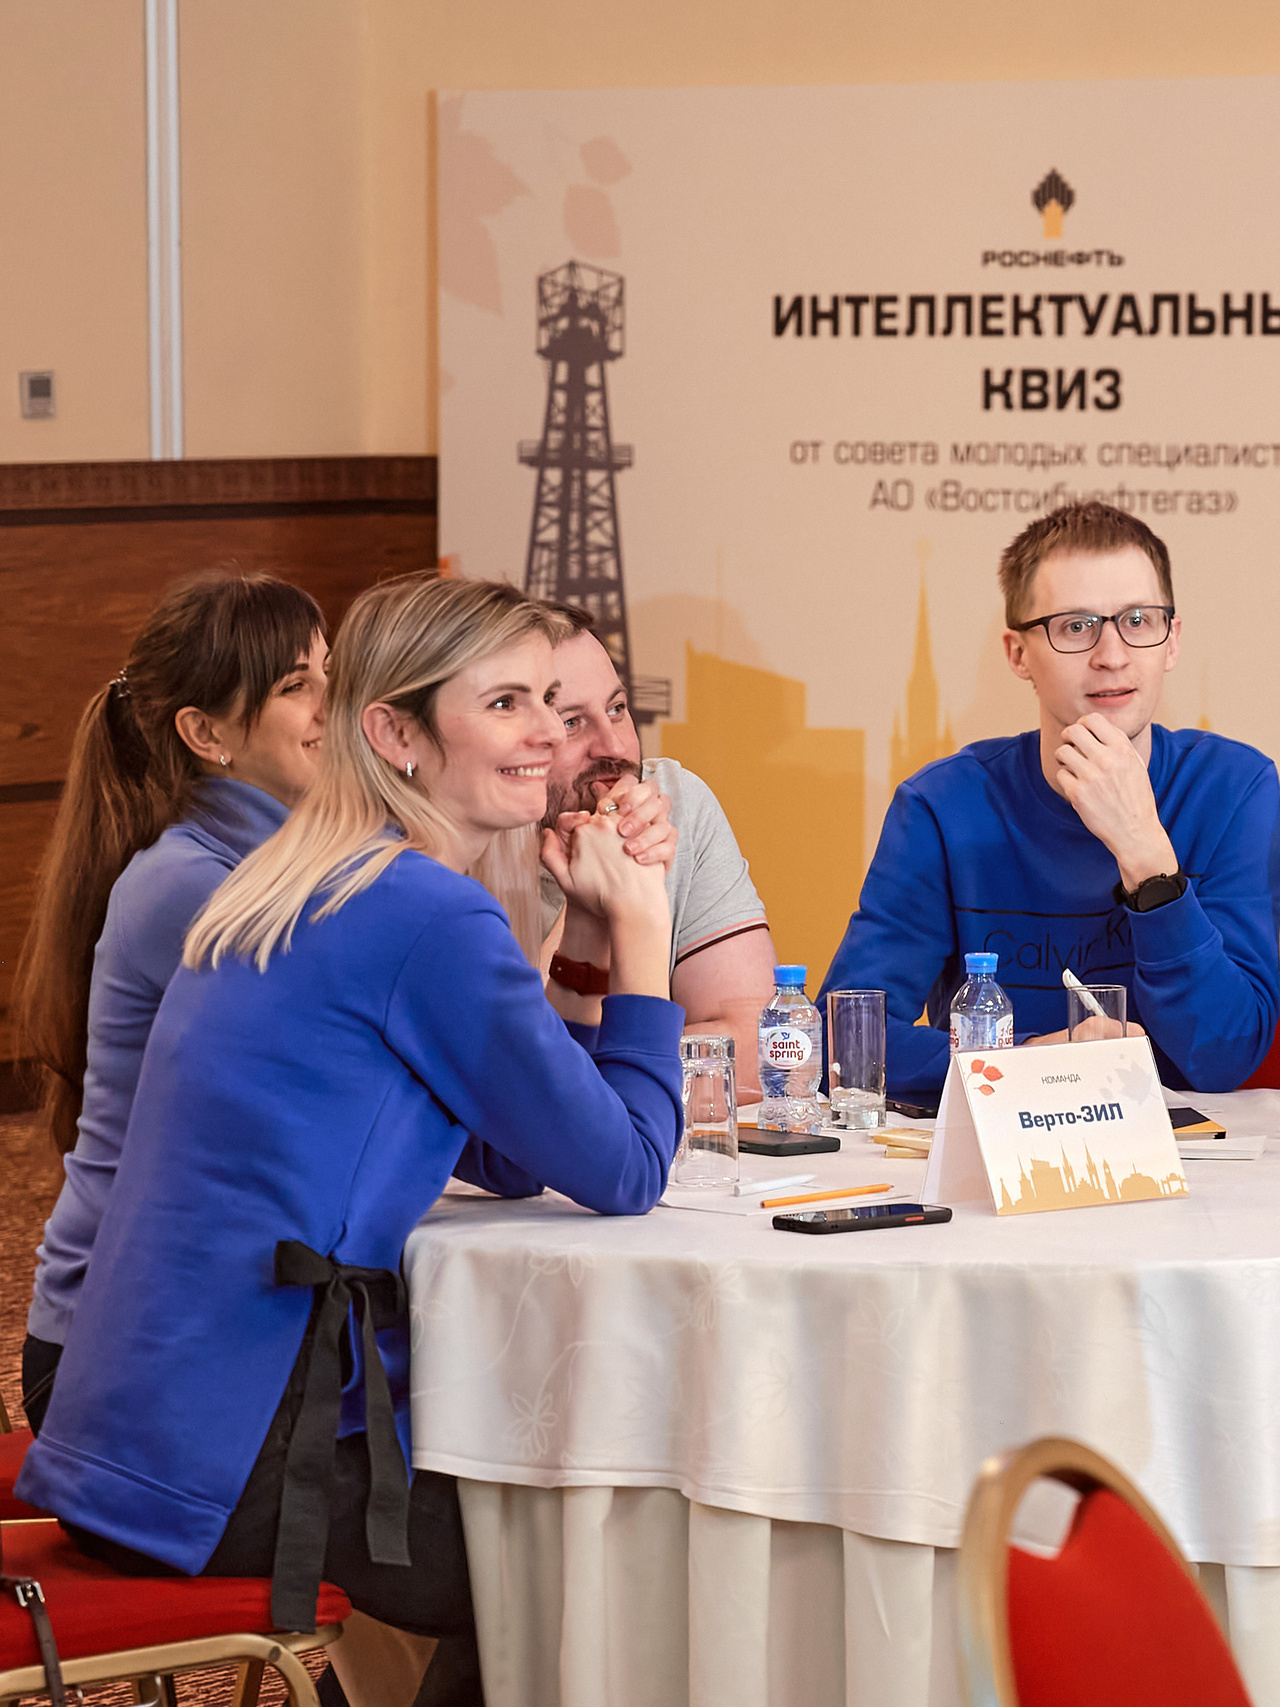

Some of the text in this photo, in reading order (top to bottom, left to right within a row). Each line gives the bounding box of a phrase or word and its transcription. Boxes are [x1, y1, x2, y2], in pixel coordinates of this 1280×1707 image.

[982, 250, 1125, 268] РОСНЕФТЬ
[982, 367, 1123, 411] КВИЗ
[789, 440, 822, 465] от
[833, 440, 939, 466] совета
[950, 440, 1088, 472] молодых
[868, 479, 915, 512] АО
[769, 1049, 804, 1061] spring
[772, 1040, 800, 1049] saint
[1018, 1102, 1124, 1131] Верто-ЗИЛ
